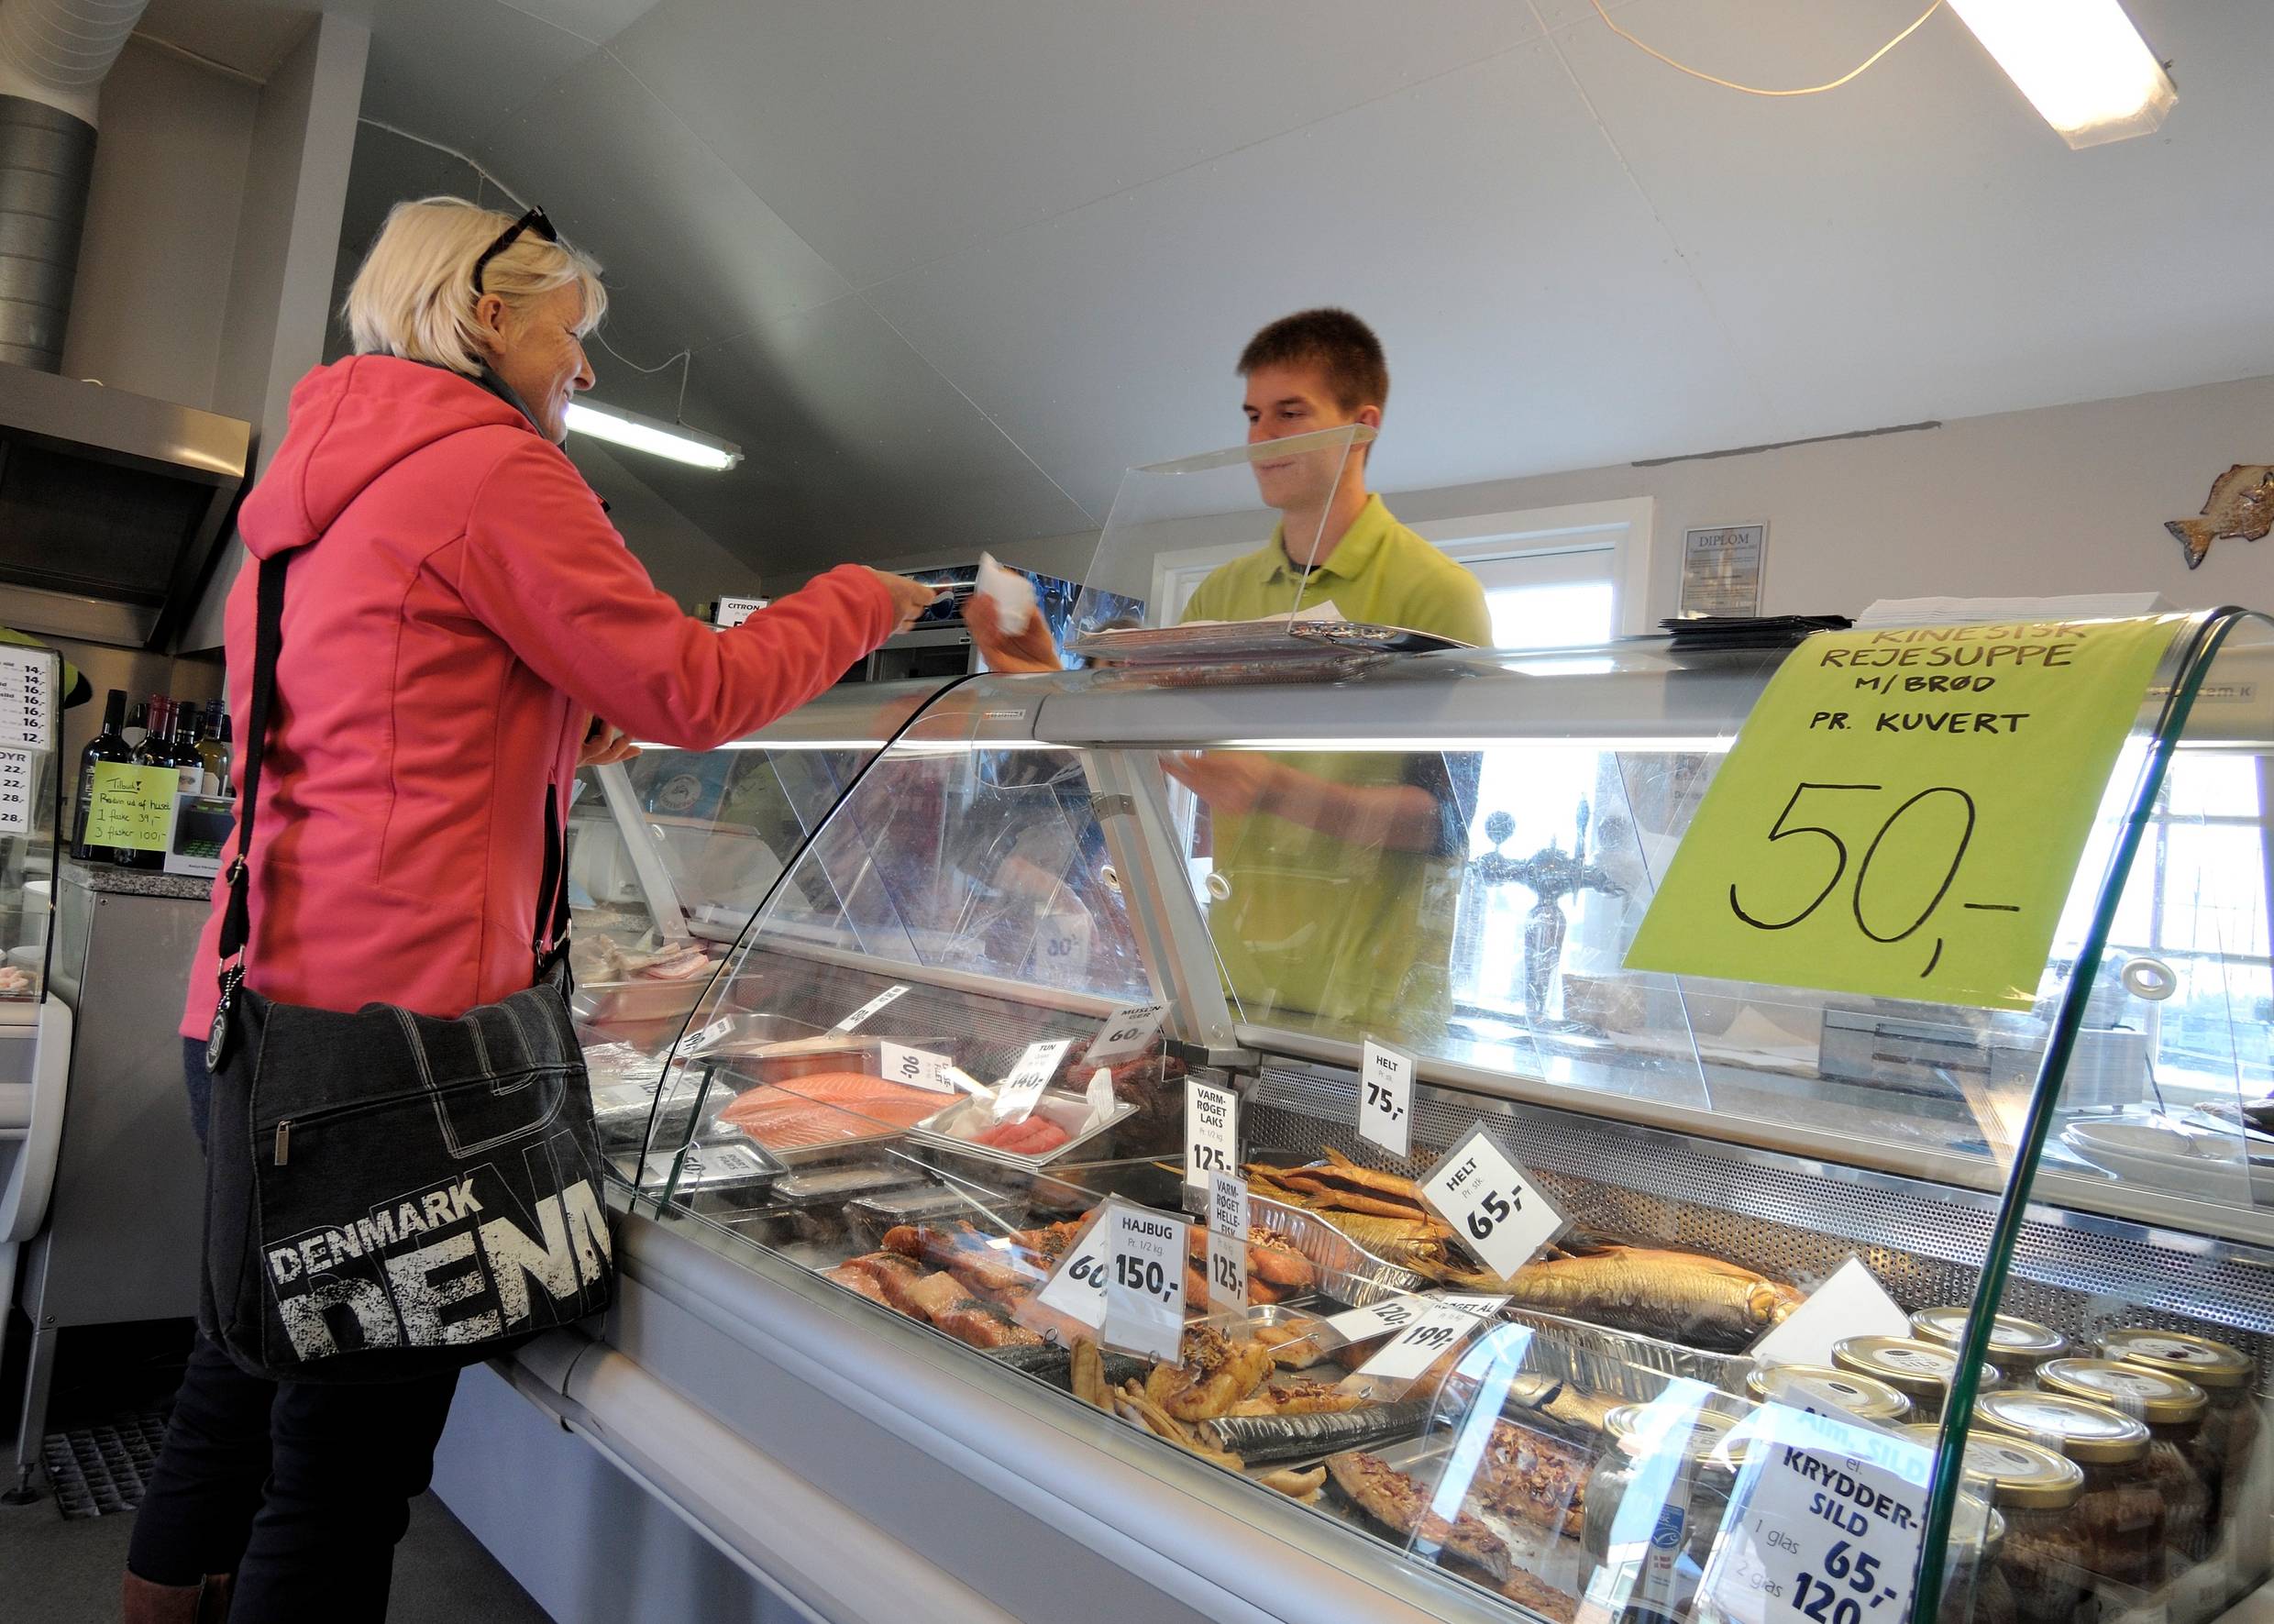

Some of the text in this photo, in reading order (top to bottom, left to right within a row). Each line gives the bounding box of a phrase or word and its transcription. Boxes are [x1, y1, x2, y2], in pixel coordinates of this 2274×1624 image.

[1699, 534, 1750, 547] DIPLOM
[727, 602, 760, 611] CITRON
[1820, 644, 2077, 668] REJESUPPE
[25, 666, 45, 675] 14,-
[25, 676, 45, 685] 14,-
[24, 686, 45, 695] 16,-
[24, 696, 45, 706] 16,-
[24, 707, 45, 717] 16,-
[23, 718, 44, 729] 16,-
[1810, 712, 2030, 734] PR. KUVERT
[23, 733, 44, 744] 12,-
[4, 765, 26, 775] 22,-
[3, 779, 26, 789] 22,-
[2, 793, 24, 803] 28,-
[1, 813, 23, 823] 28,-
[96, 810, 105, 822] 1
[94, 827, 103, 838] 3
[1730, 782, 2020, 979] 50,-
[900, 1055, 921, 1078] 90,-
[1376, 1055, 1398, 1071] HELT
[1198, 1088, 1226, 1104] VARM-
[1367, 1082, 1404, 1121] 75,-
[1197, 1099, 1227, 1117] RØGET
[1200, 1112, 1224, 1129] LAKS
[1194, 1143, 1231, 1171] 125-
[1446, 1157, 1479, 1192] HELT
[1217, 1179, 1240, 1197] VARM-
[1217, 1194, 1240, 1213] RØGET
[1467, 1185, 1522, 1240] 65,-
[1217, 1208, 1241, 1227] HELLE-
[268, 1177, 484, 1285] DENMARK
[1122, 1217, 1173, 1240] HAJBUG
[1140, 1240, 1152, 1251] 1/2
[1116, 1254, 1178, 1303] 150,-
[1212, 1253, 1243, 1300] 125,-
[1372, 1303, 1411, 1326] 120,-
[1403, 1326, 1454, 1351] 199,-
[1846, 1457, 1863, 1475] el.
[1783, 1445, 1918, 1530] KRYDDER-
[1809, 1491, 1869, 1538] SILD
[1755, 1519, 1898, 1608] 1 glas 65,-
[1737, 1562, 1748, 1576] 2
[1750, 1571, 1783, 1598] glas
